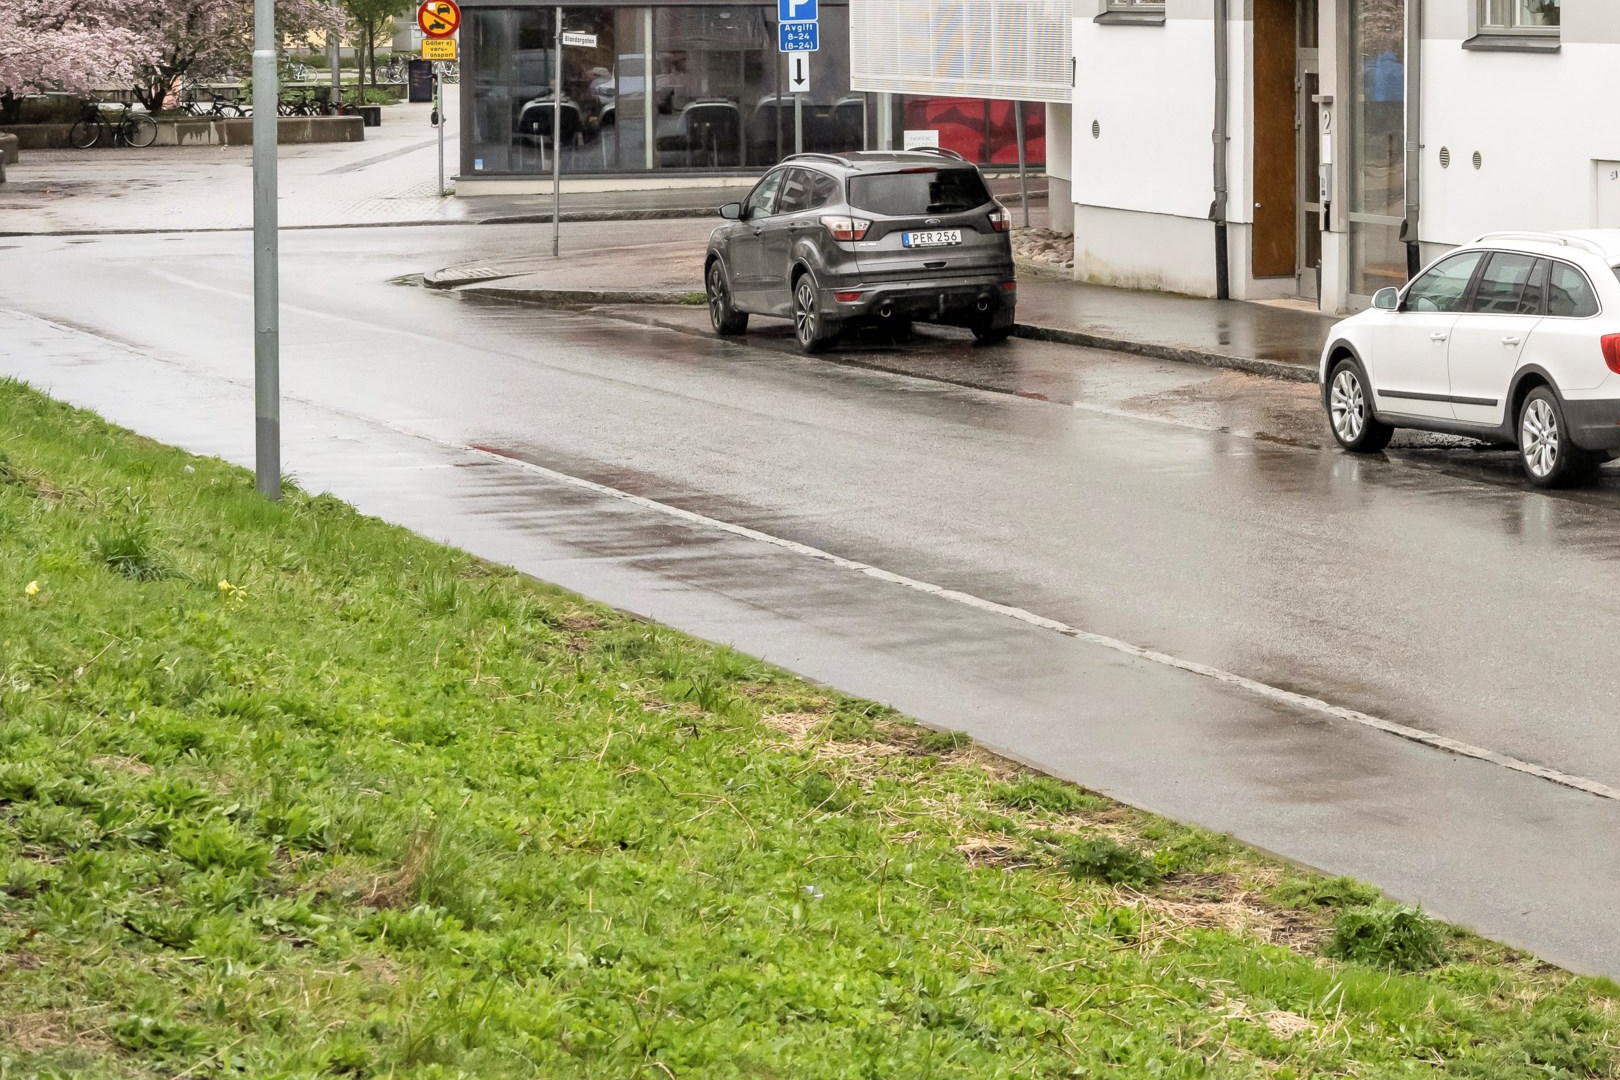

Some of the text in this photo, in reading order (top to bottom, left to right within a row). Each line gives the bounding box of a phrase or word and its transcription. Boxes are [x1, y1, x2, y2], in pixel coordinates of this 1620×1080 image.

[784, 23, 813, 32] Avgift
[788, 32, 810, 41] 8-24
[784, 41, 814, 51] (8-24)
[1322, 110, 1332, 134] 2
[912, 231, 958, 244] PER 256
